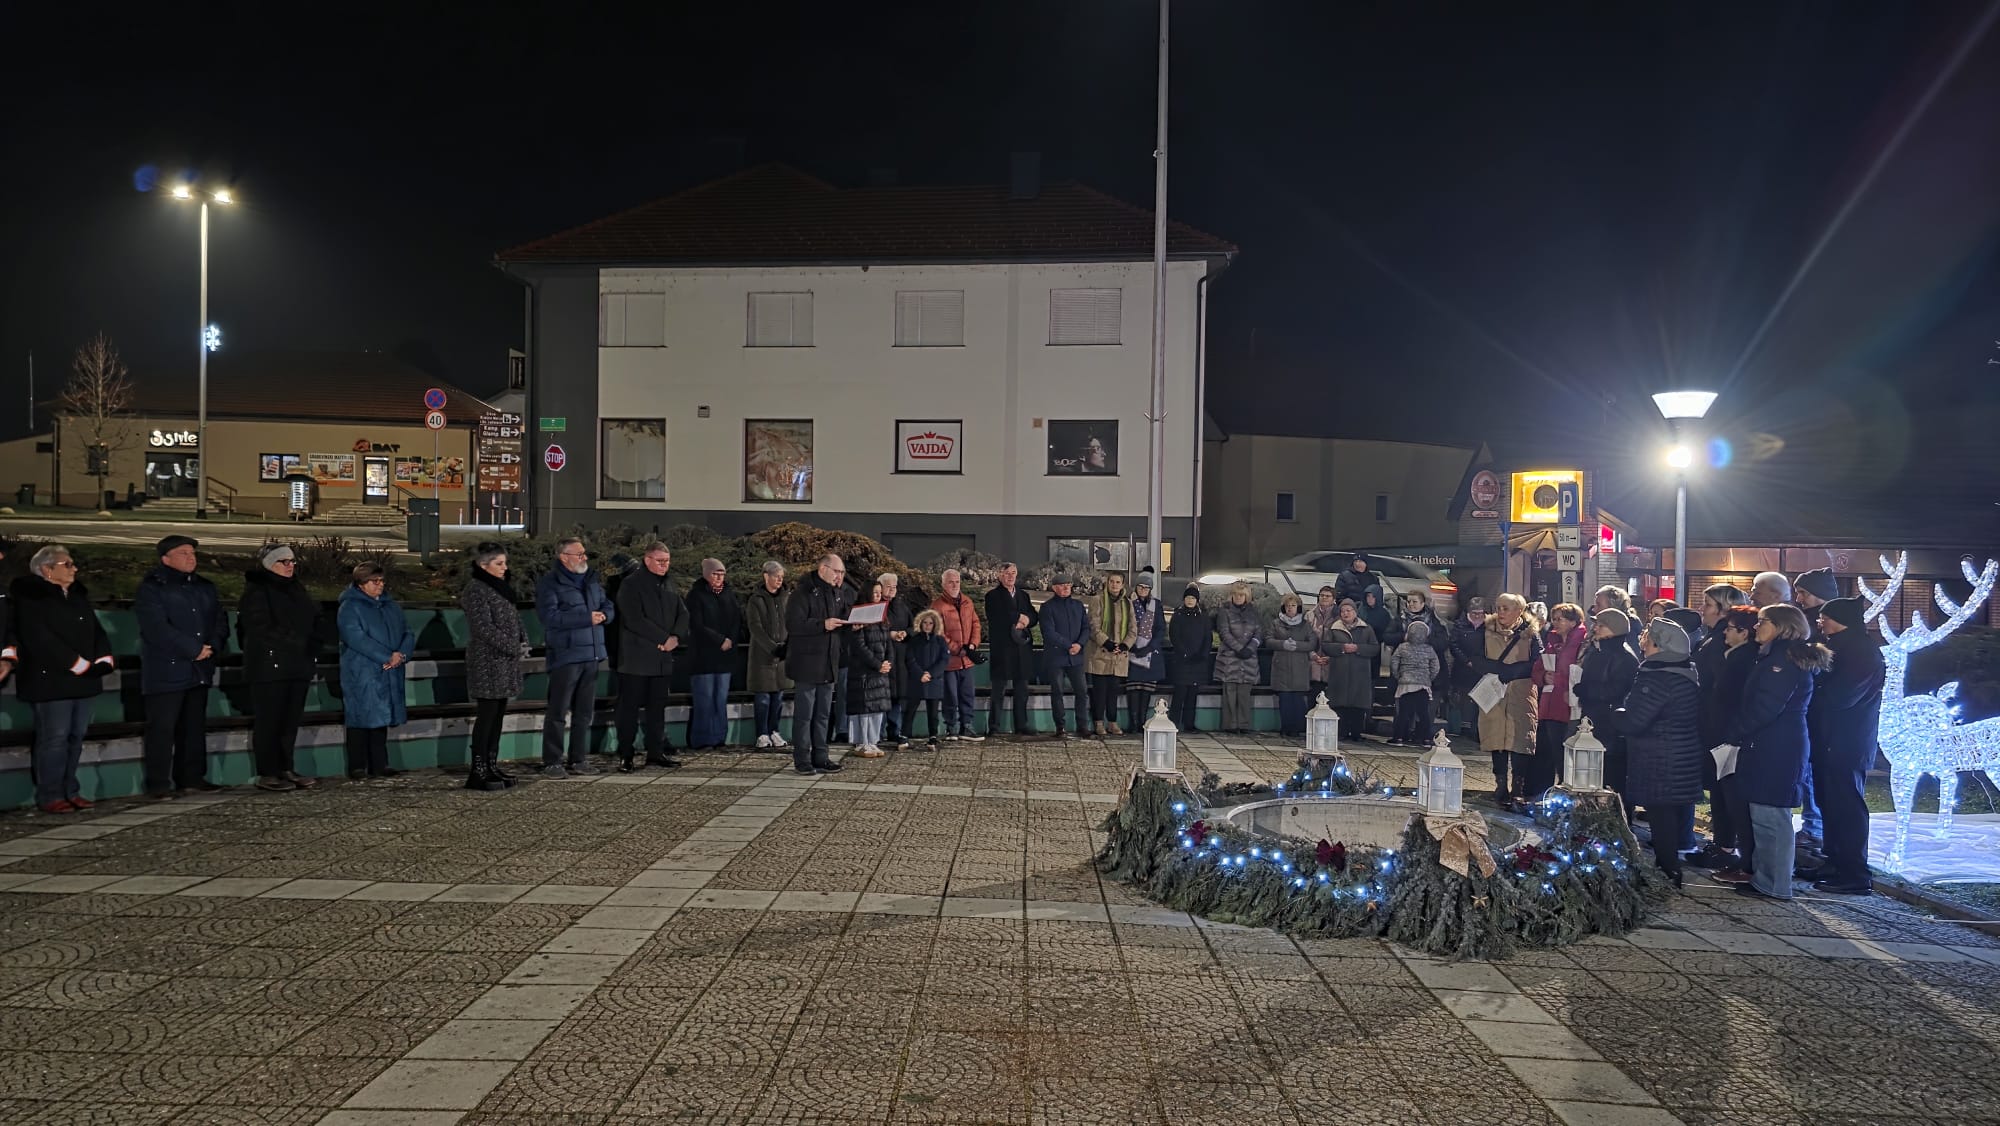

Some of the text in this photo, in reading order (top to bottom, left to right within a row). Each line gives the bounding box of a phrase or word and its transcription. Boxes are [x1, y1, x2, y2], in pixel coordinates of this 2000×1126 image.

[429, 415, 442, 426] 40
[911, 443, 948, 455] VAJDA
[546, 452, 564, 464] STOP
[1562, 490, 1573, 518] P
[1559, 533, 1565, 542] 50
[1405, 555, 1456, 565] eineken
[1562, 555, 1576, 566] WC
